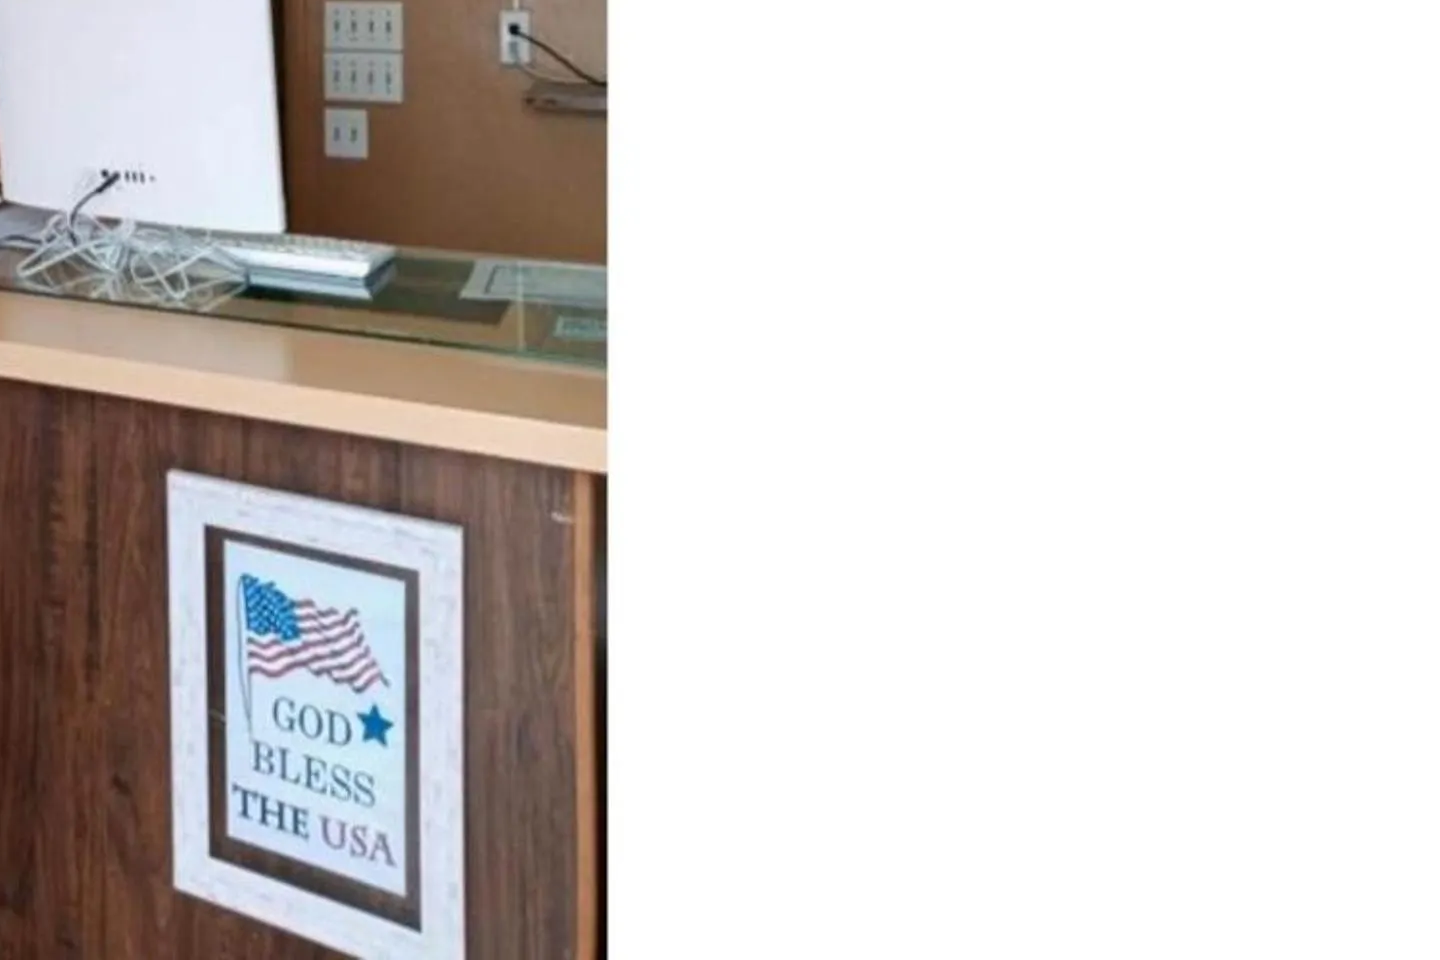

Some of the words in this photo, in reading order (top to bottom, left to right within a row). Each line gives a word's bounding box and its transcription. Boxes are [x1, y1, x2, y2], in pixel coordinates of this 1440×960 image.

[271, 696, 353, 747] GOD
[252, 740, 376, 808] BLESS
[231, 783, 310, 840] THE
[320, 815, 397, 868] USA
